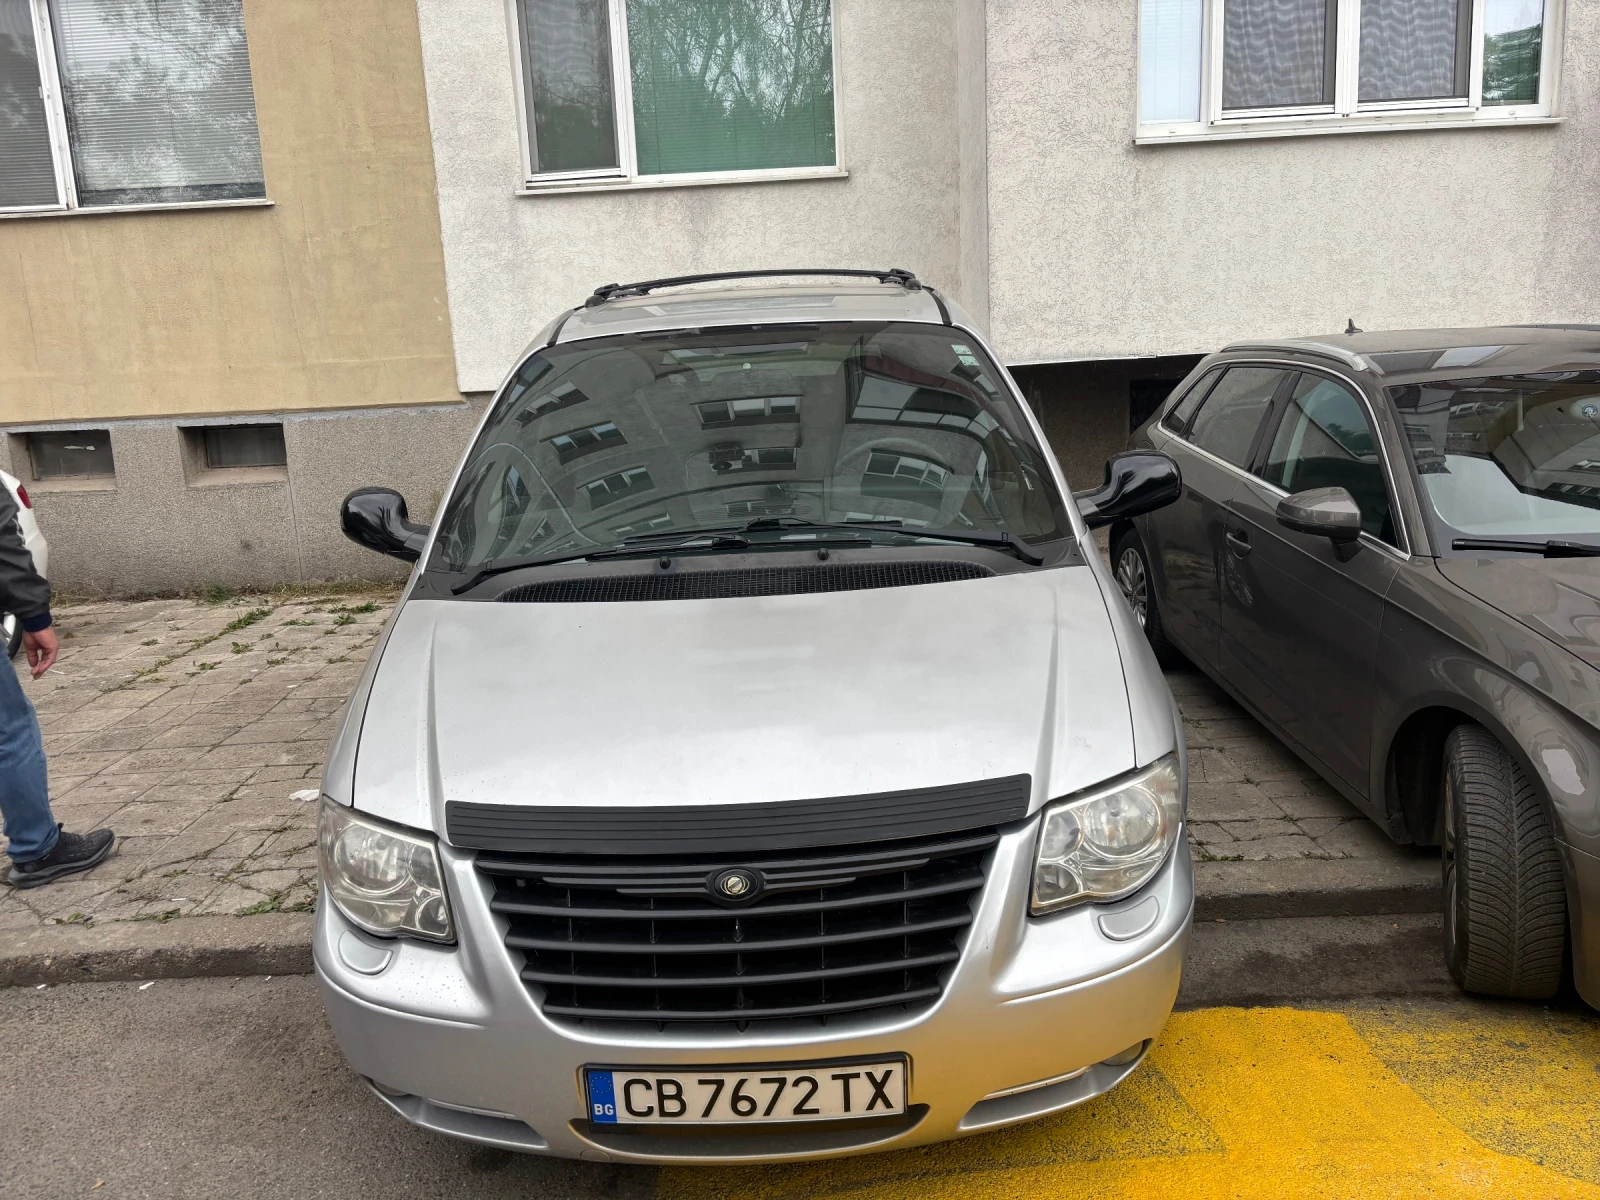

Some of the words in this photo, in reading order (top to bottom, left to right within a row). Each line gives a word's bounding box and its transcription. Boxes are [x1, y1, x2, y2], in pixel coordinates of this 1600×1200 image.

[624, 1078, 688, 1118] CB
[697, 1076, 820, 1118] 7672
[831, 1069, 895, 1113] TX
[593, 1103, 614, 1116] BG
